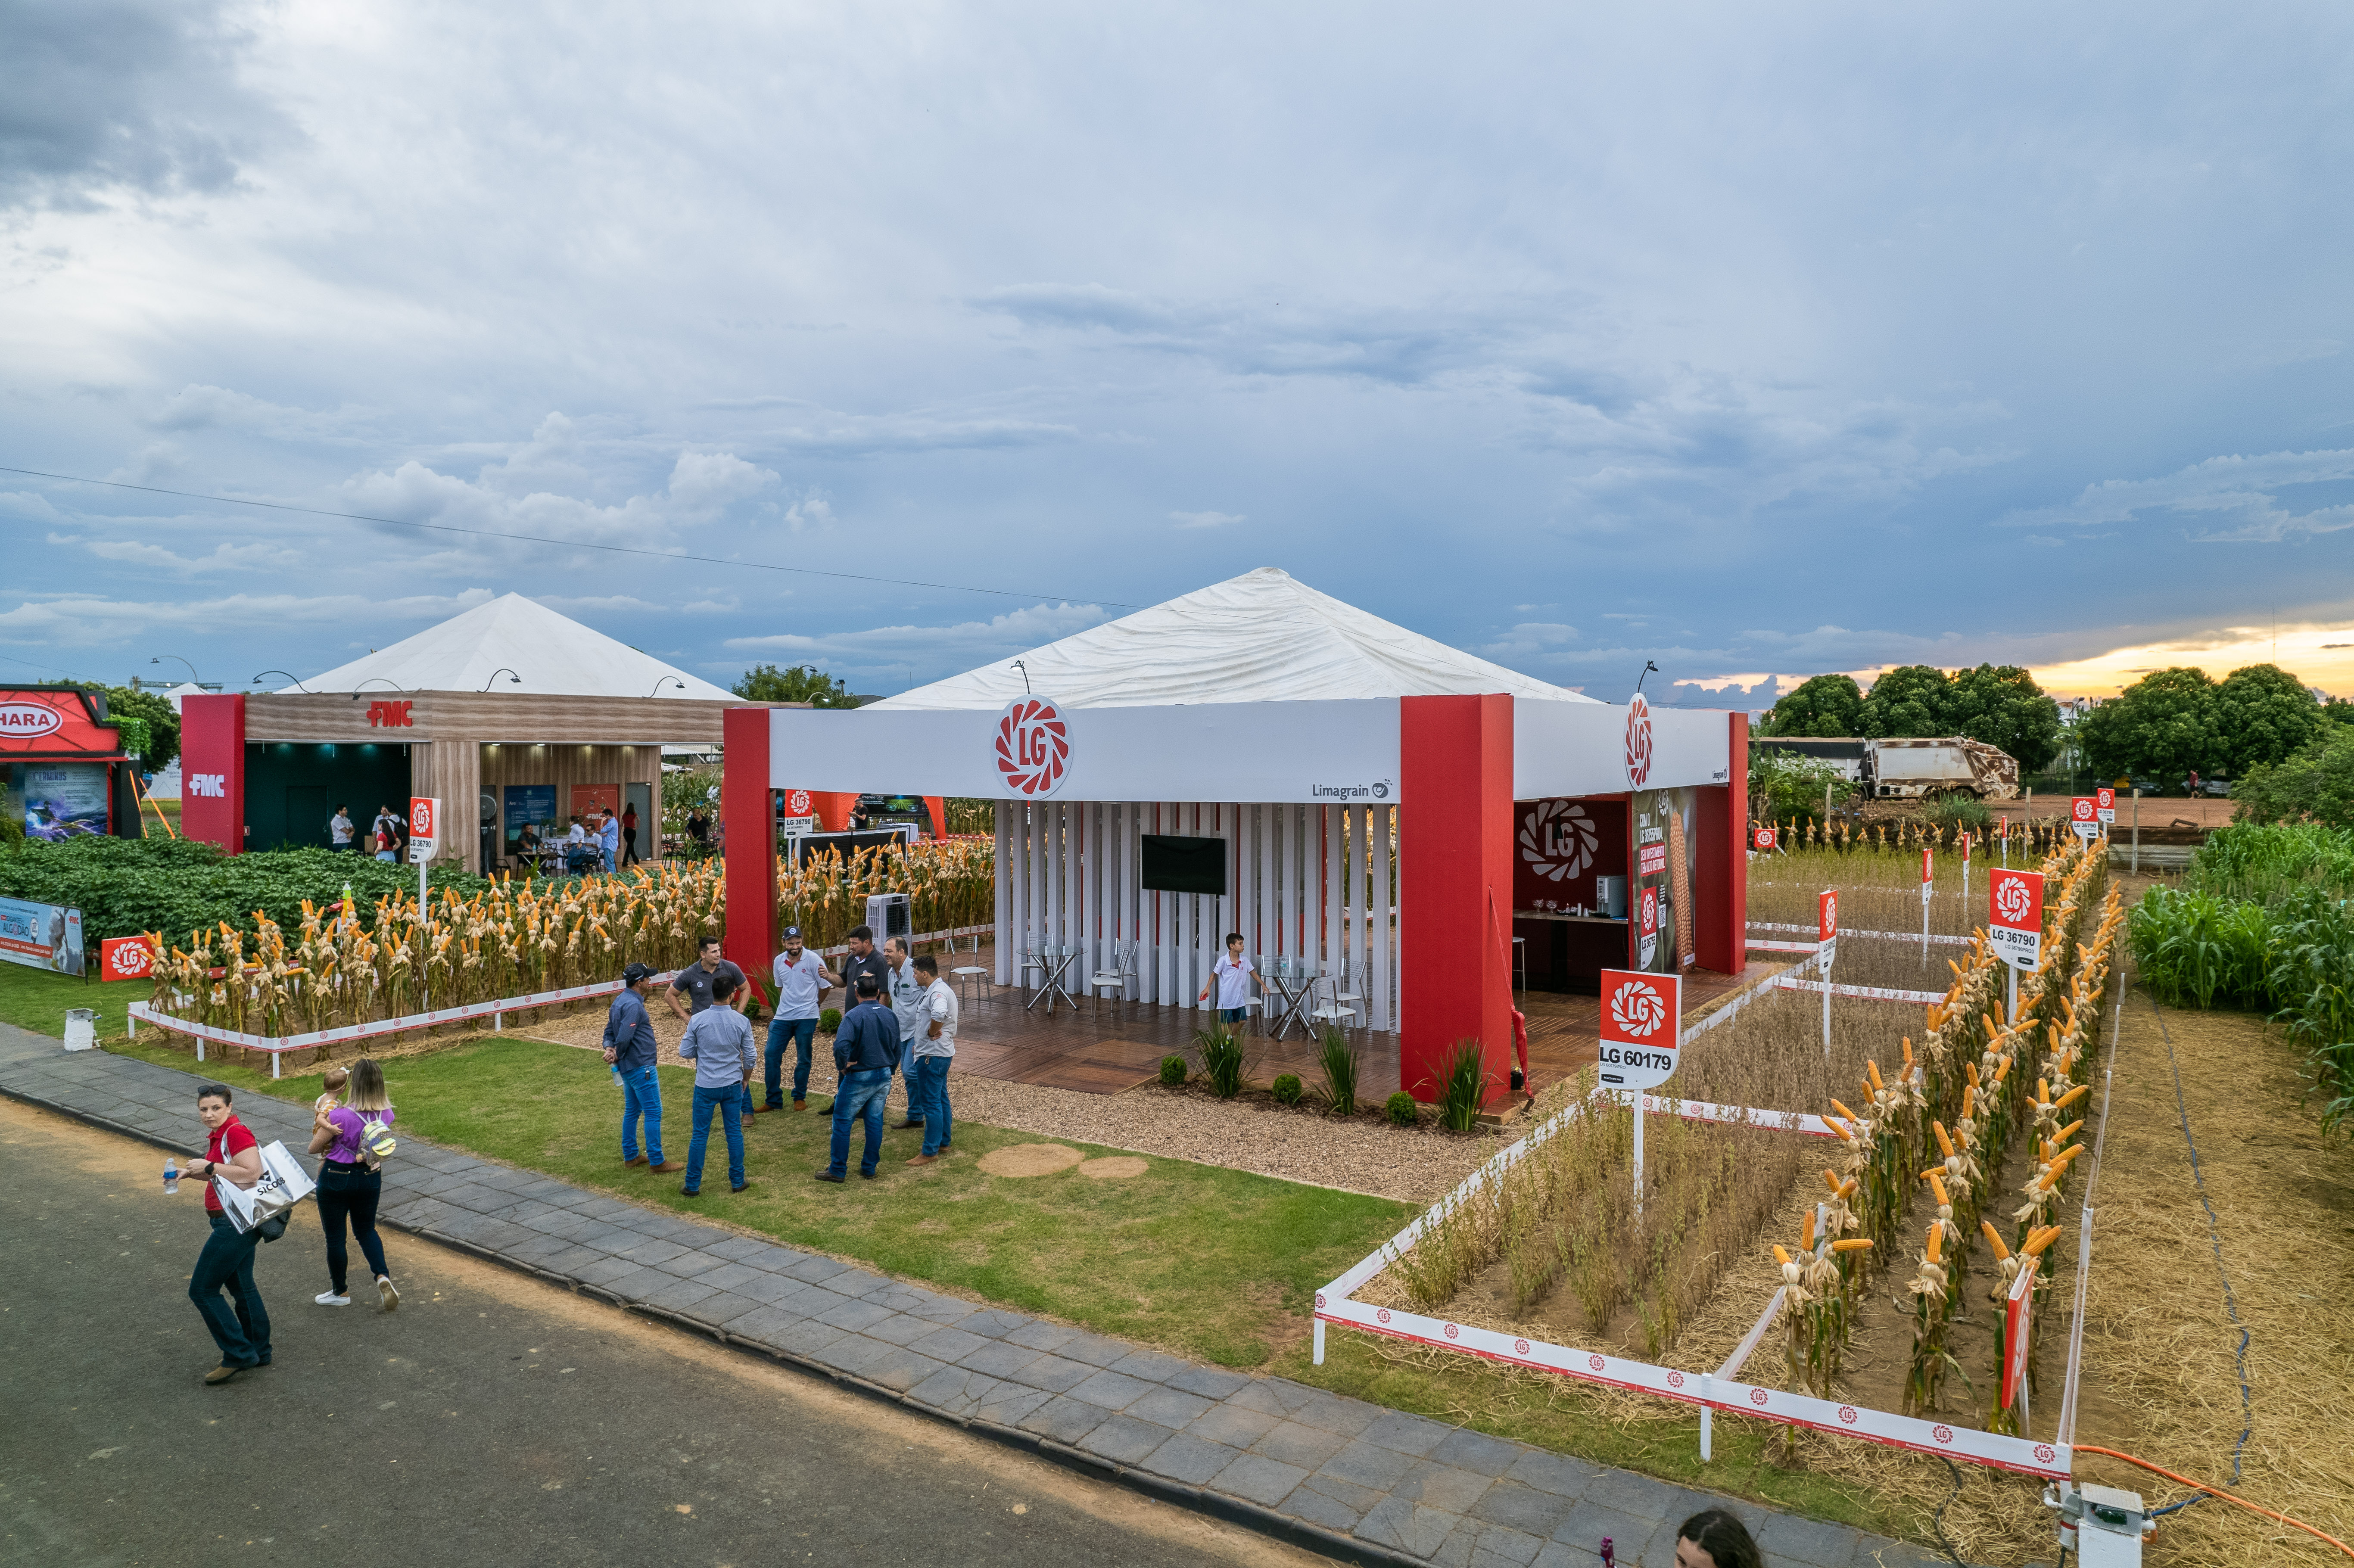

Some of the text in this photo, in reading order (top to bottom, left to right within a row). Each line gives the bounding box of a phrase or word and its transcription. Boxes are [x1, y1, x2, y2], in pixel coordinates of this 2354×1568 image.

[366, 700, 412, 727] FMC
[1019, 726, 1046, 766] LG
[1635, 724, 1645, 760] LG
[189, 773, 224, 797] FMC
[1313, 784, 1369, 800] Limagrain
[797, 796, 804, 807] LG
[1661, 791, 1666, 806] LG
[2080, 805, 2088, 814] LG
[418, 811, 425, 824] LG
[417, 840, 431, 848] 36790
[1545, 823, 1574, 857] LG
[1640, 829, 1644, 844] LG
[2007, 889, 2020, 909] LG
[1647, 903, 1651, 920] LG
[69, 915, 79, 925] FMC
[1642, 939, 1646, 950] LG
[1993, 929, 2035, 946] LG 36790
[1823, 943, 1828, 952] LG
[123, 951, 138, 965] LG
[1628, 996, 1649, 1021] LG
[1600, 1047, 1672, 1071] LG 60179
[257, 1177, 286, 1196] SICOOB
[1726, 1405, 1750, 1413] Produtividade
[1813, 1424, 1838, 1432] Produtividade
[1906, 1443, 1934, 1452] Produtividade
[1937, 1450, 1959, 1458] Tecnologia
[2005, 1463, 2035, 1473] Produtividade
[2039, 1469, 2062, 1478] Tecnologia
